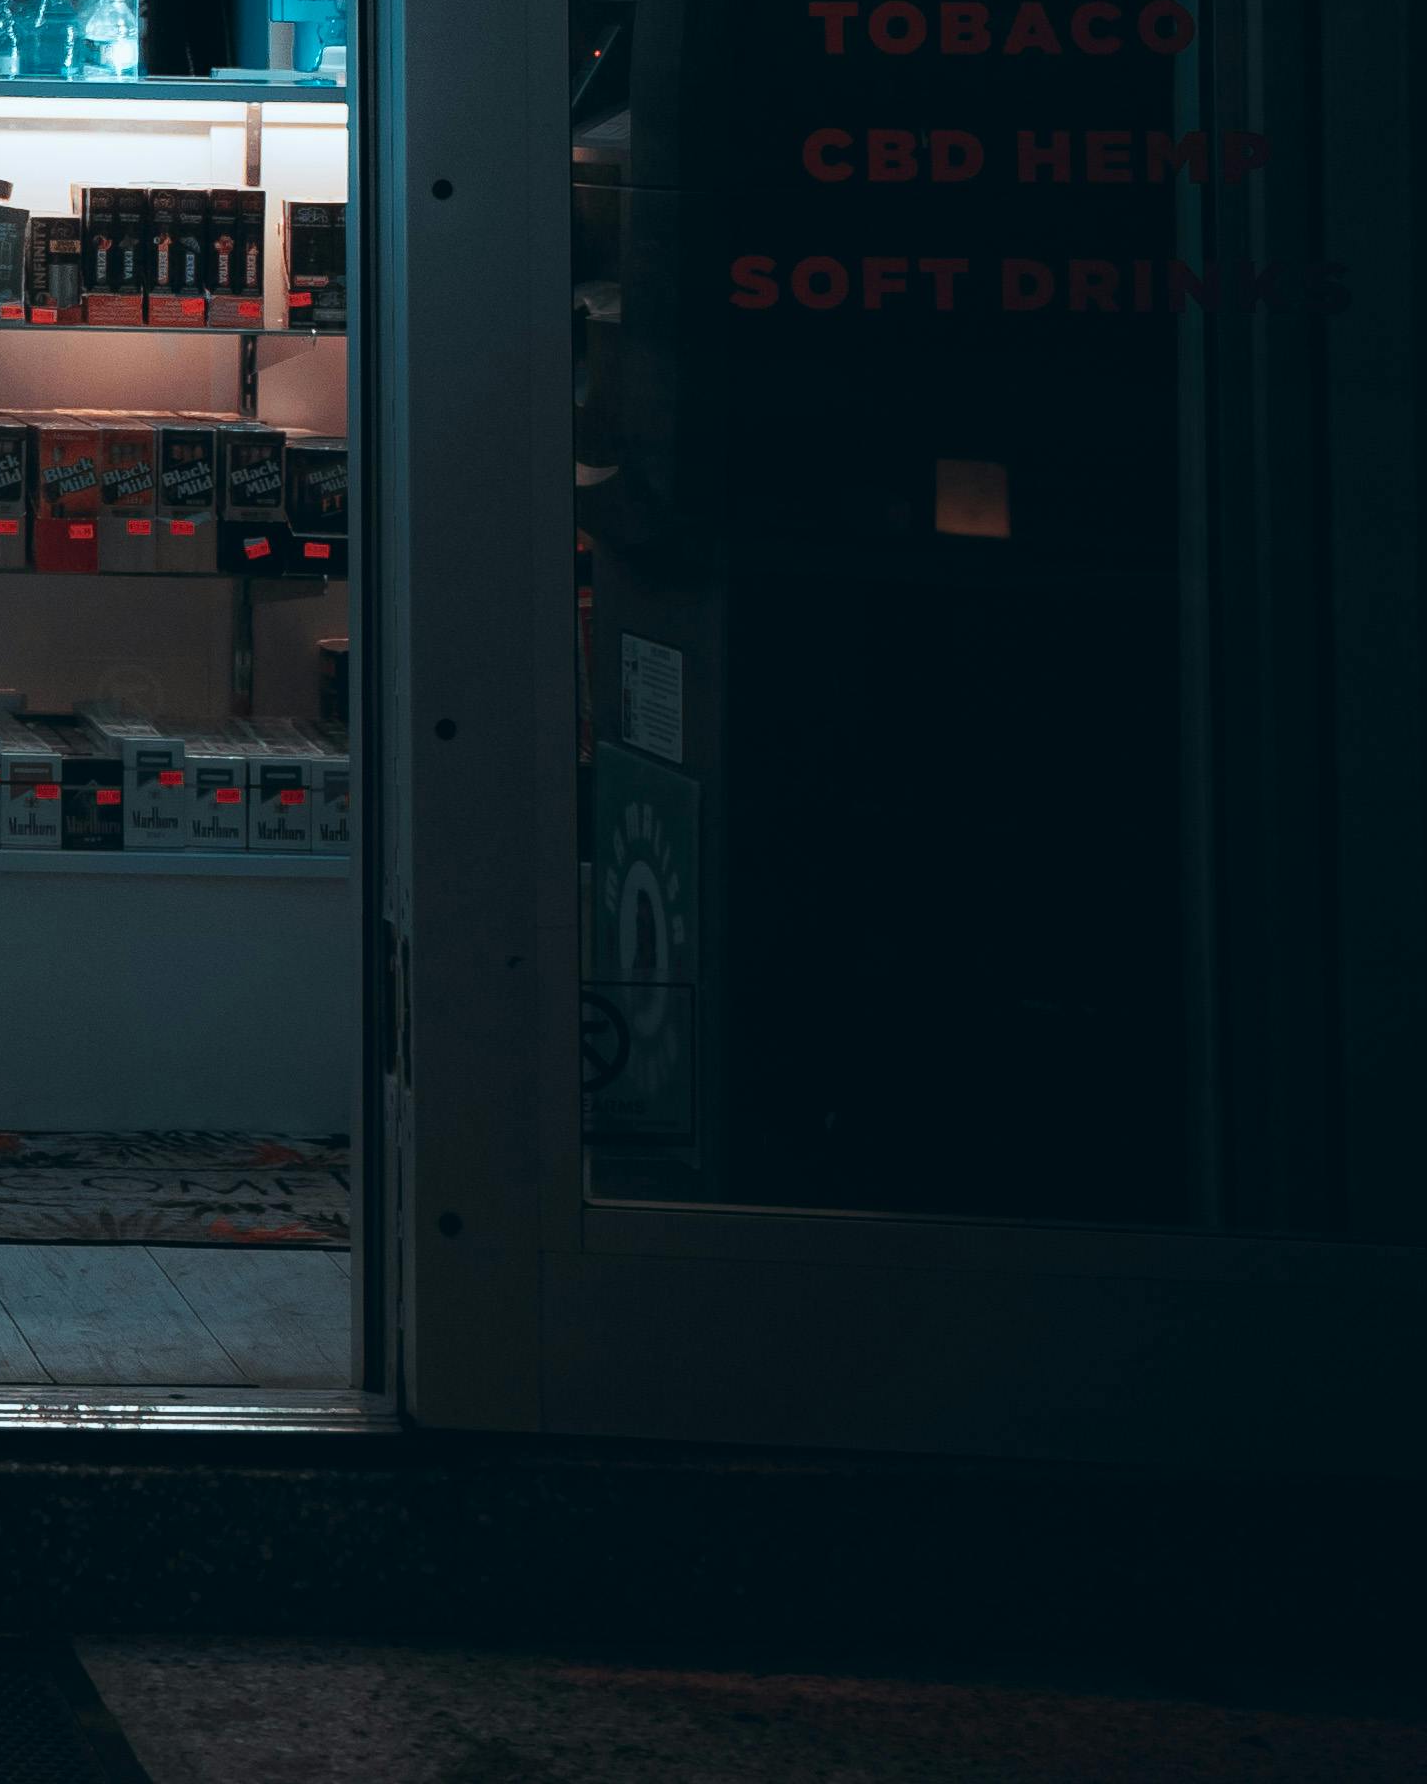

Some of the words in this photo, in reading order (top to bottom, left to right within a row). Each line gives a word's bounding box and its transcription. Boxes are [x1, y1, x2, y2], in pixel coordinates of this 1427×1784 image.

[801, 127, 986, 185] CBD
[1016, 127, 1275, 185] HEMP
[728, 253, 970, 314] SOFT
[1001, 256, 1351, 314] DRINKS
[45, 458, 94, 483] Black
[102, 462, 150, 485] Black
[162, 462, 211, 487] Black
[231, 460, 281, 485] Black
[59, 473, 96, 496] Mild
[116, 475, 154, 497] Mild
[177, 476, 214, 499] Mild
[245, 475, 282, 499] Mild
[320, 818, 350, 842] Marlb
[582, 1098, 646, 1116] EARMS
